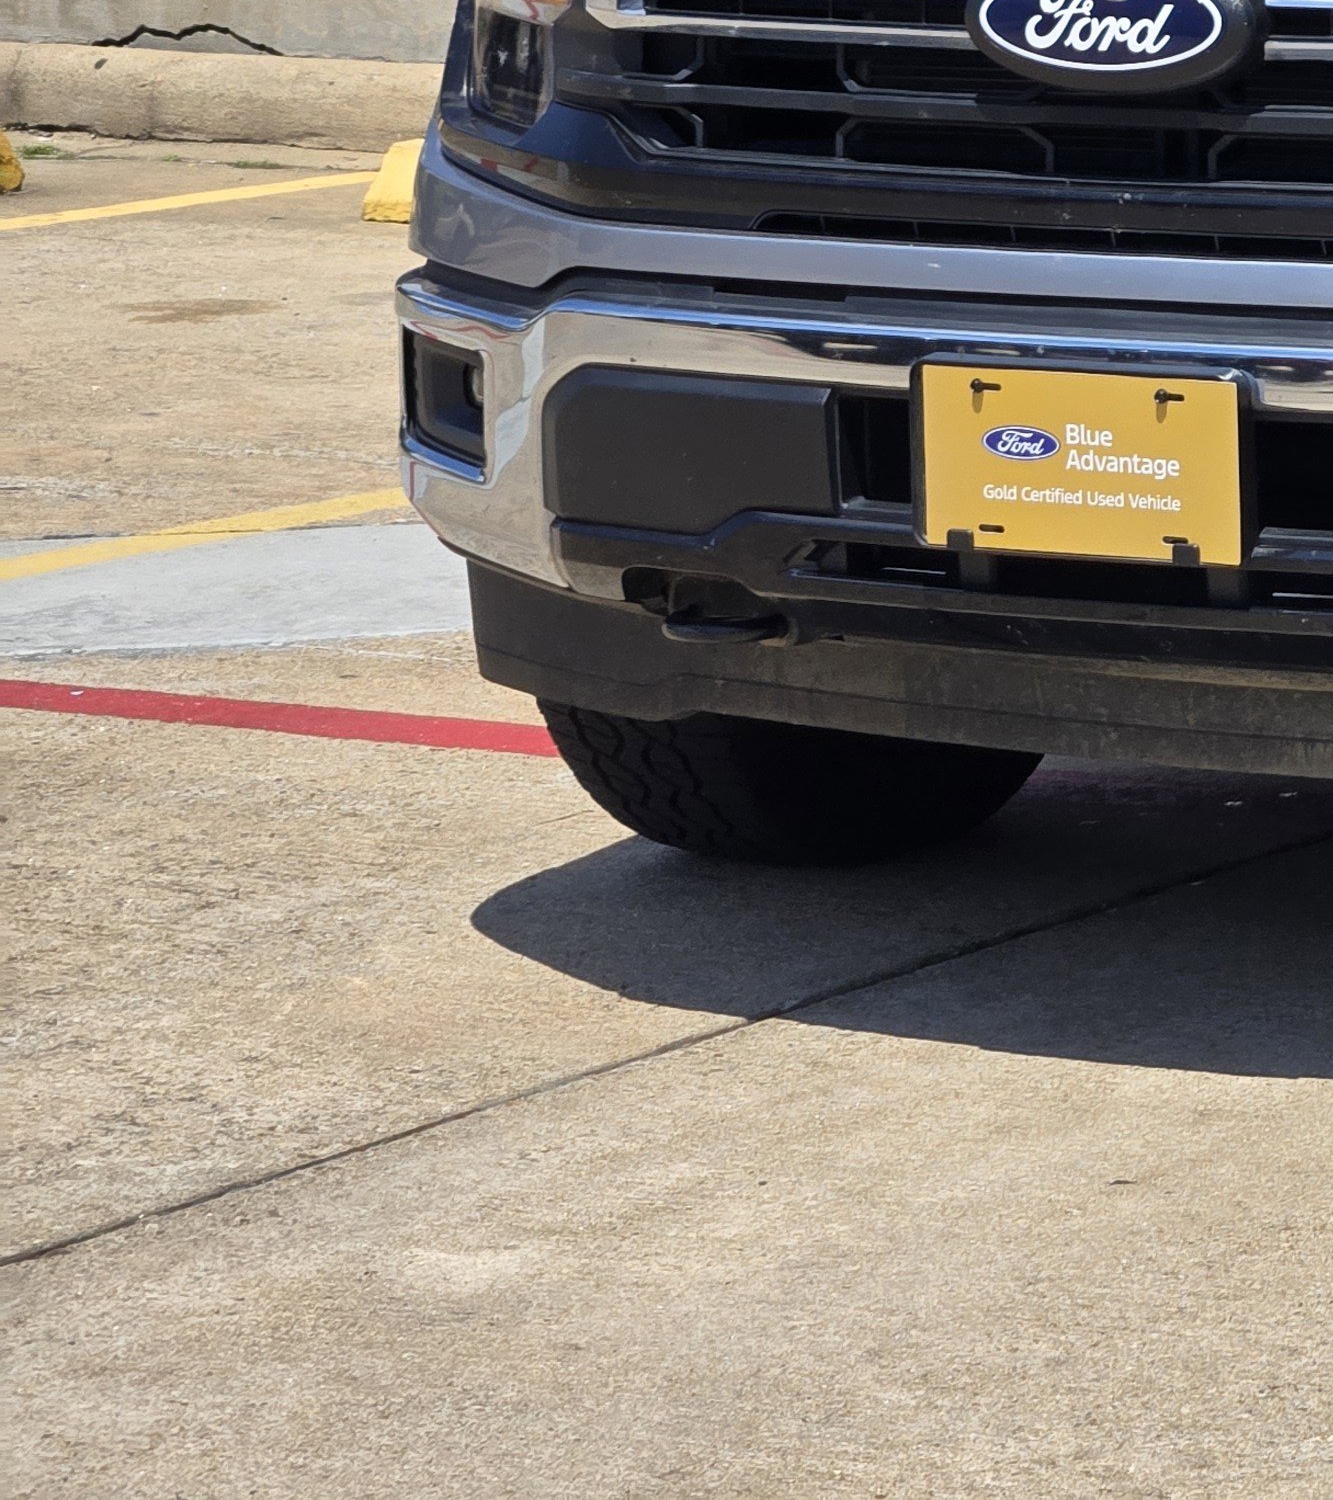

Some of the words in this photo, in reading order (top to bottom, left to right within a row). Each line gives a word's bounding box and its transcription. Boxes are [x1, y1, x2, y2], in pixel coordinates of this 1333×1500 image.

[997, 430, 1045, 455] Ford
[1065, 423, 1114, 447] Blue
[1065, 450, 1181, 480] Advantage
[983, 484, 1018, 501] Gold
[1021, 486, 1083, 505] Certified
[1087, 491, 1125, 508] Used
[1128, 493, 1182, 512] Vehicle
